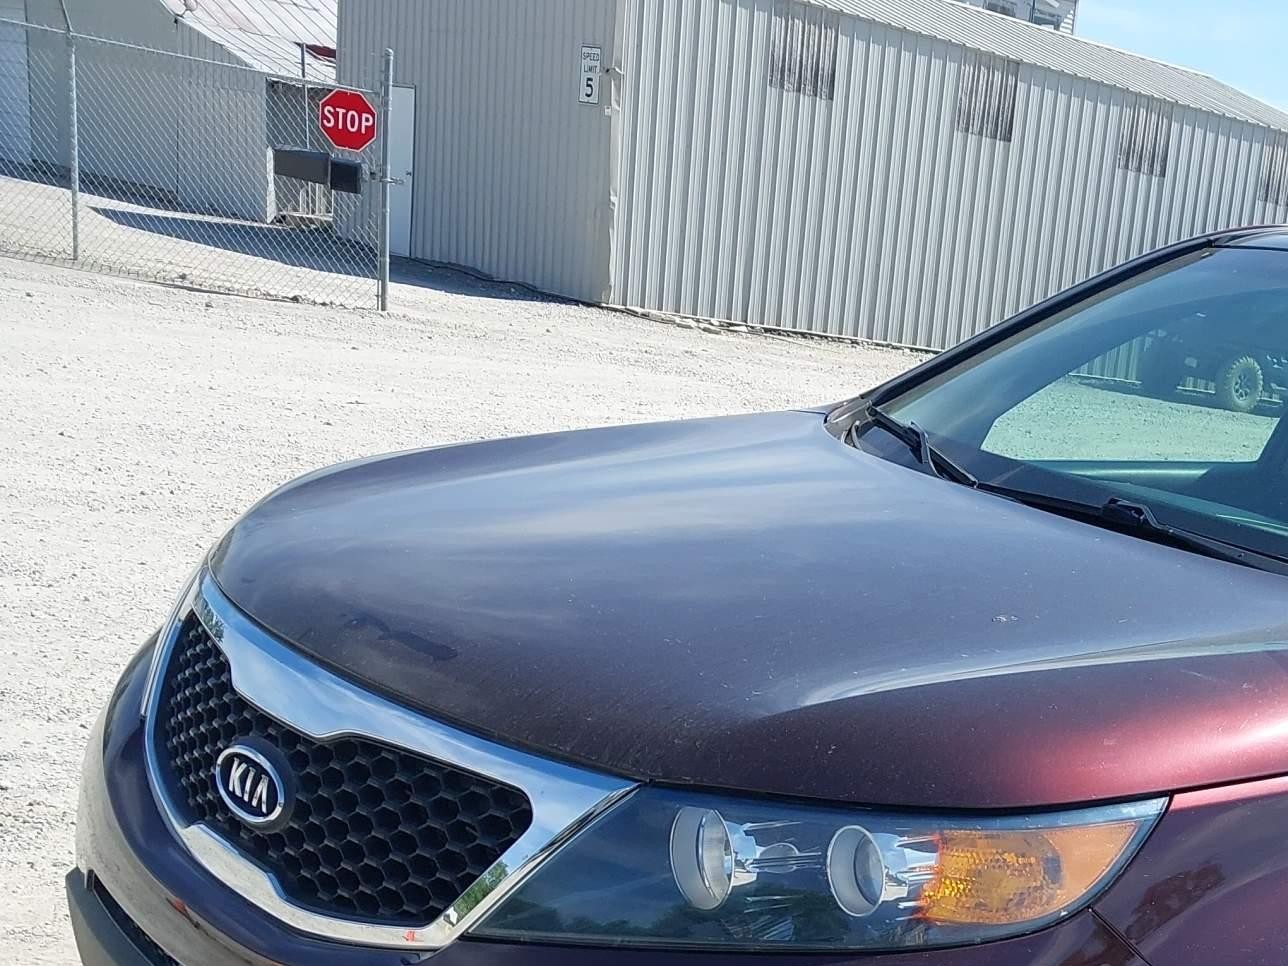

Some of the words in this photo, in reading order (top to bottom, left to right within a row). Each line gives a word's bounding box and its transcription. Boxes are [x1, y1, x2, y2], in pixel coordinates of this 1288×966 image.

[582, 52, 599, 61] SPEED
[583, 64, 597, 74] LIMIT
[585, 78, 593, 97] 5
[323, 106, 373, 134] STOP
[228, 757, 269, 815] KIA
